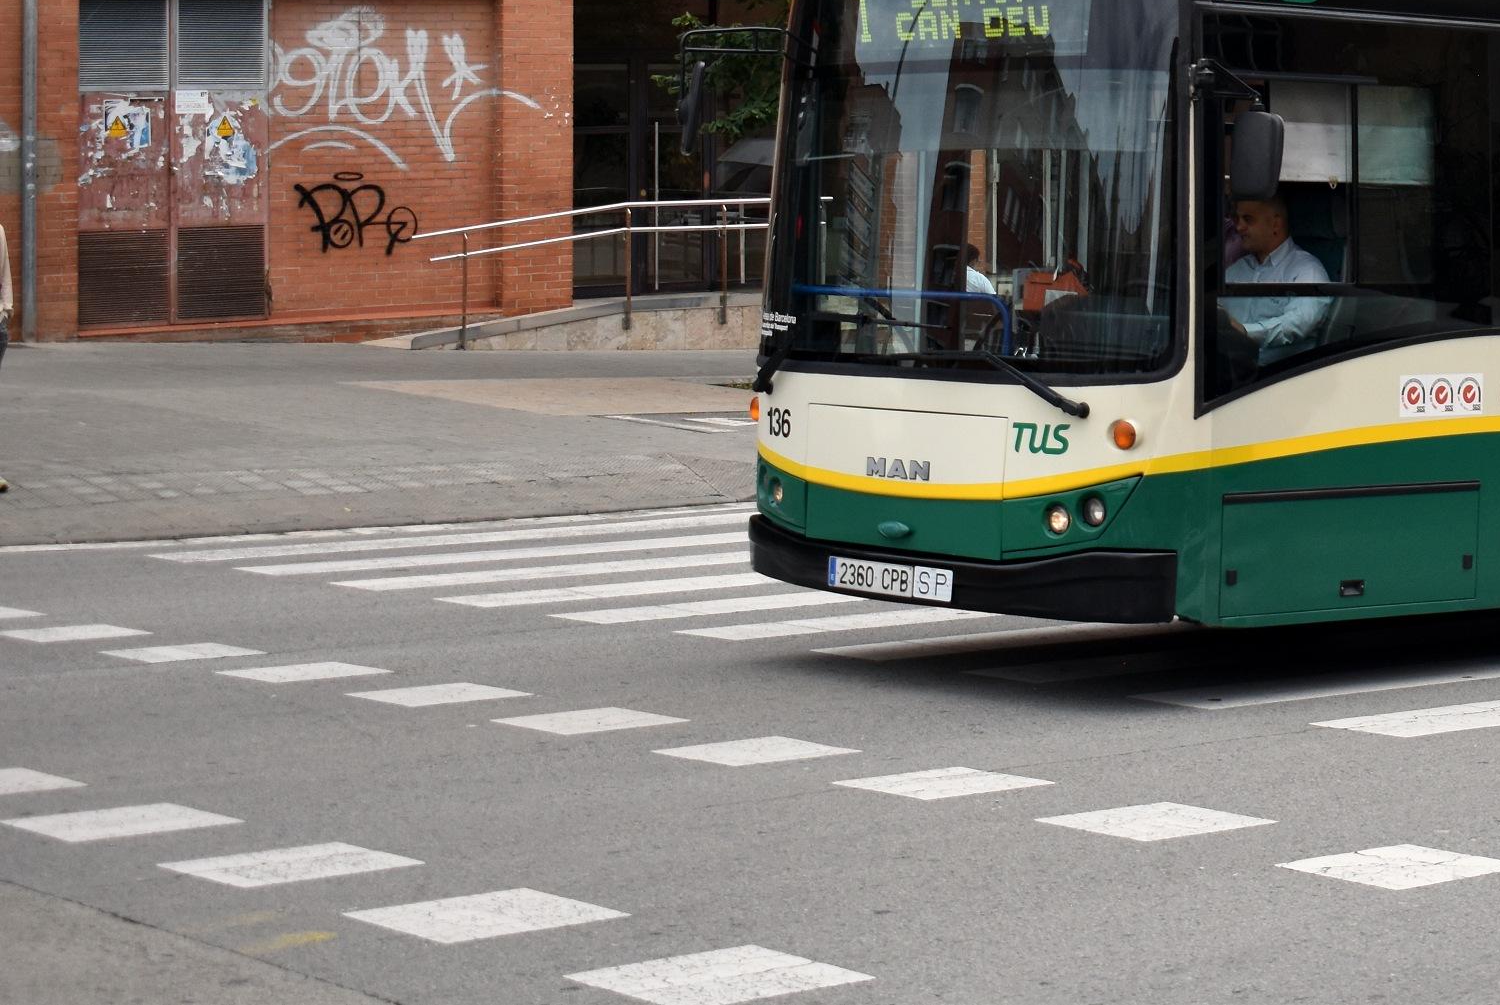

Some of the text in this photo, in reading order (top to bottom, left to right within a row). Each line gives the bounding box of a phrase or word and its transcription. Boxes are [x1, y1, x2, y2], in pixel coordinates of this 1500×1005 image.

[896, 5, 1049, 41] CAN DEU
[767, 407, 791, 438] 136
[1013, 422, 1071, 455] TUS
[866, 457, 931, 481] MAN
[839, 563, 874, 587] 2360
[882, 568, 909, 592] CPB
